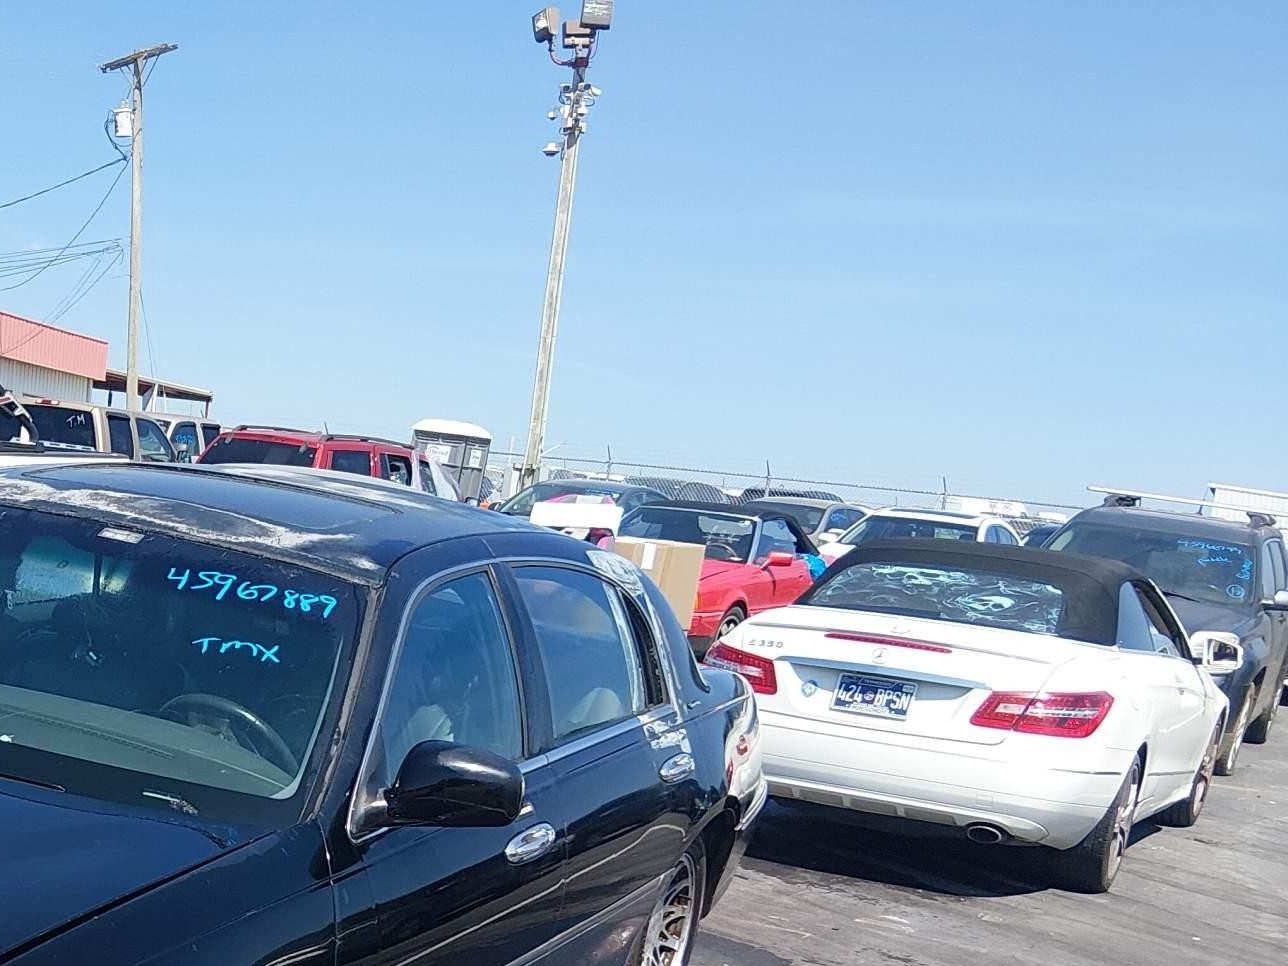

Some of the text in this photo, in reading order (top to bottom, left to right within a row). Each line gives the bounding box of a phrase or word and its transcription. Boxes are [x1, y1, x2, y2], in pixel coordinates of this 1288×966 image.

[167, 567, 338, 619] 45967889
[837, 683, 863, 703] 424
[873, 688, 911, 710] BPSN
